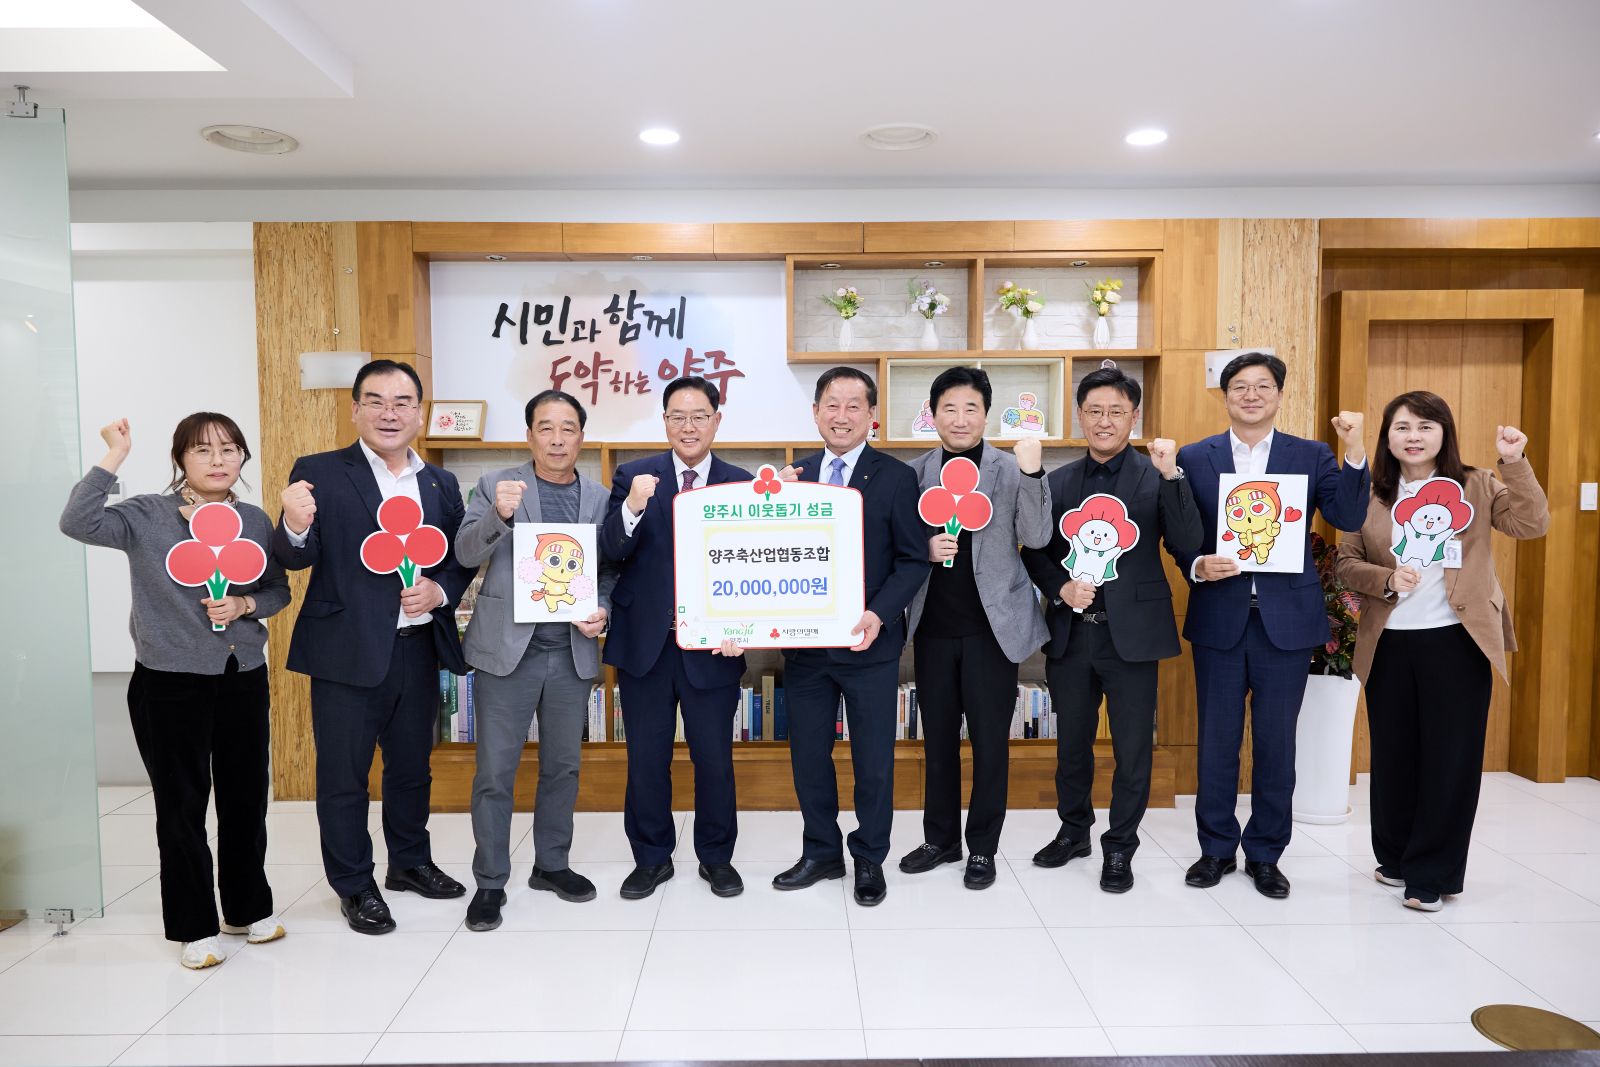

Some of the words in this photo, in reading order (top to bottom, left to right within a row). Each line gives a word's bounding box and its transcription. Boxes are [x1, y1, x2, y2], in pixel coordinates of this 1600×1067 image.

[492, 296, 602, 346] 시민과
[603, 289, 687, 346] 함께
[549, 352, 652, 406] 도약하는
[703, 504, 743, 519] 양주시
[748, 503, 801, 518] 이웃돕기
[806, 502, 833, 517] 성금
[708, 547, 831, 564] 양주축산업협동조합
[712, 577, 828, 598] 20,000,000원
